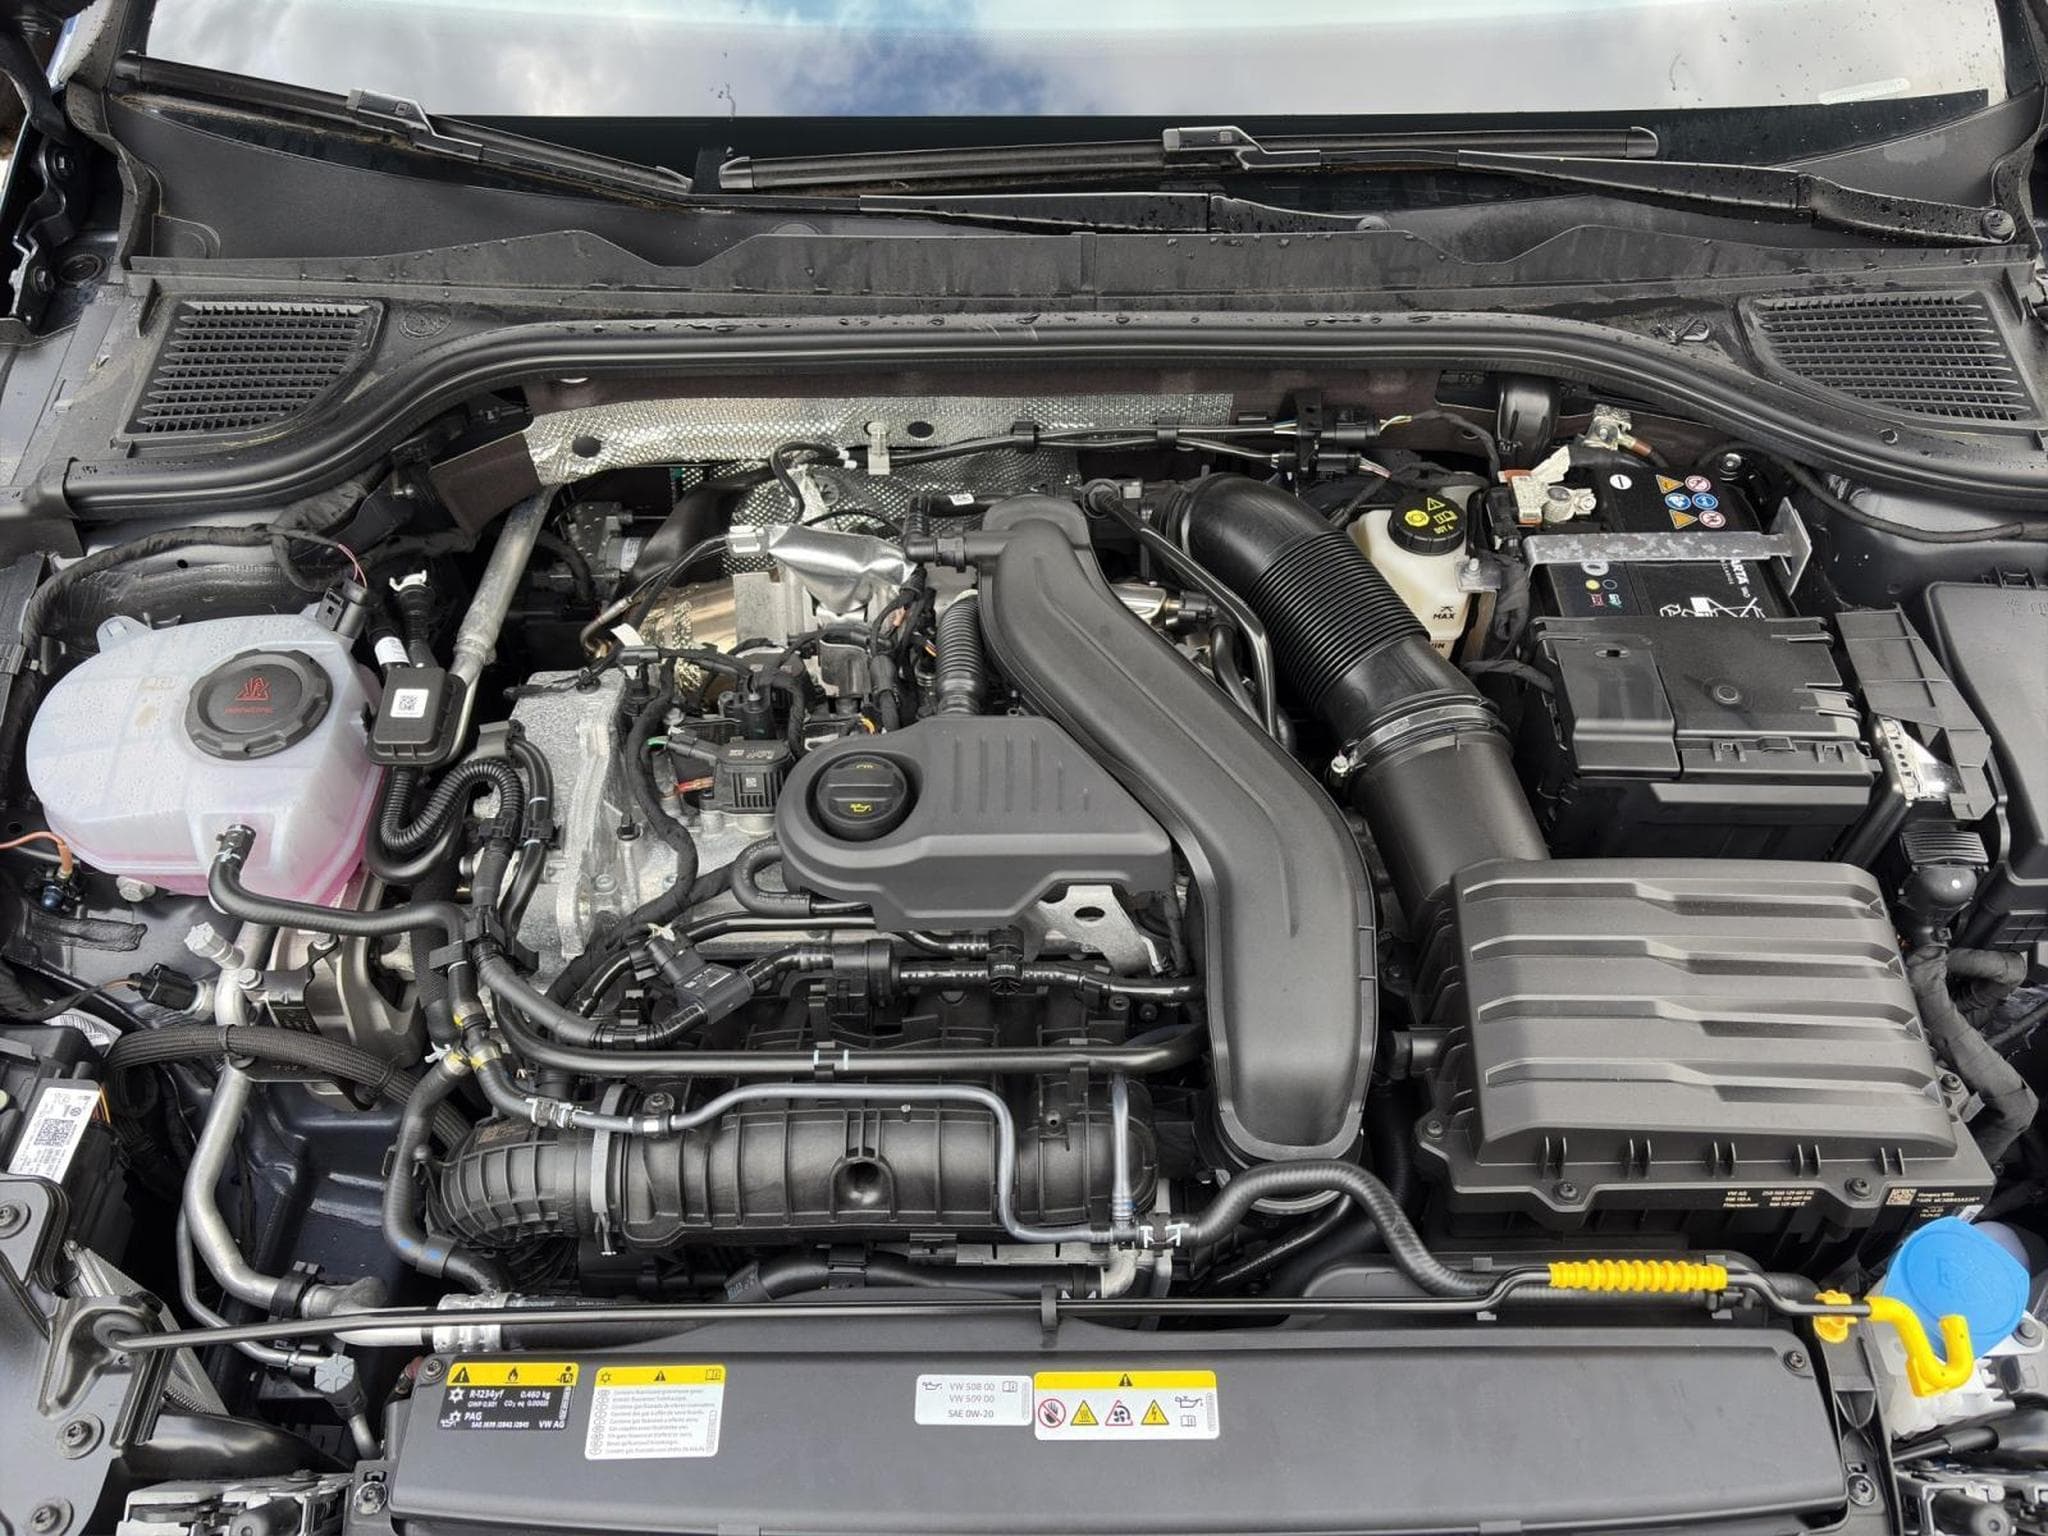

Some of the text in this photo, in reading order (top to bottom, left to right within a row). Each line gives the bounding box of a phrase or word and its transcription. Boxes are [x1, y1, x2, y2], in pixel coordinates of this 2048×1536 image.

[1730, 559, 1750, 585] ARTA
[949, 1382, 996, 1391] VW 508 00
[469, 1389, 505, 1401] R-1234yf
[542, 1390, 552, 1400] kg
[949, 1394, 995, 1403] VW 509 00
[464, 1411, 482, 1421] PAG
[948, 1409, 995, 1418] SAE 0W-20
[539, 1420, 565, 1429] VW AG
